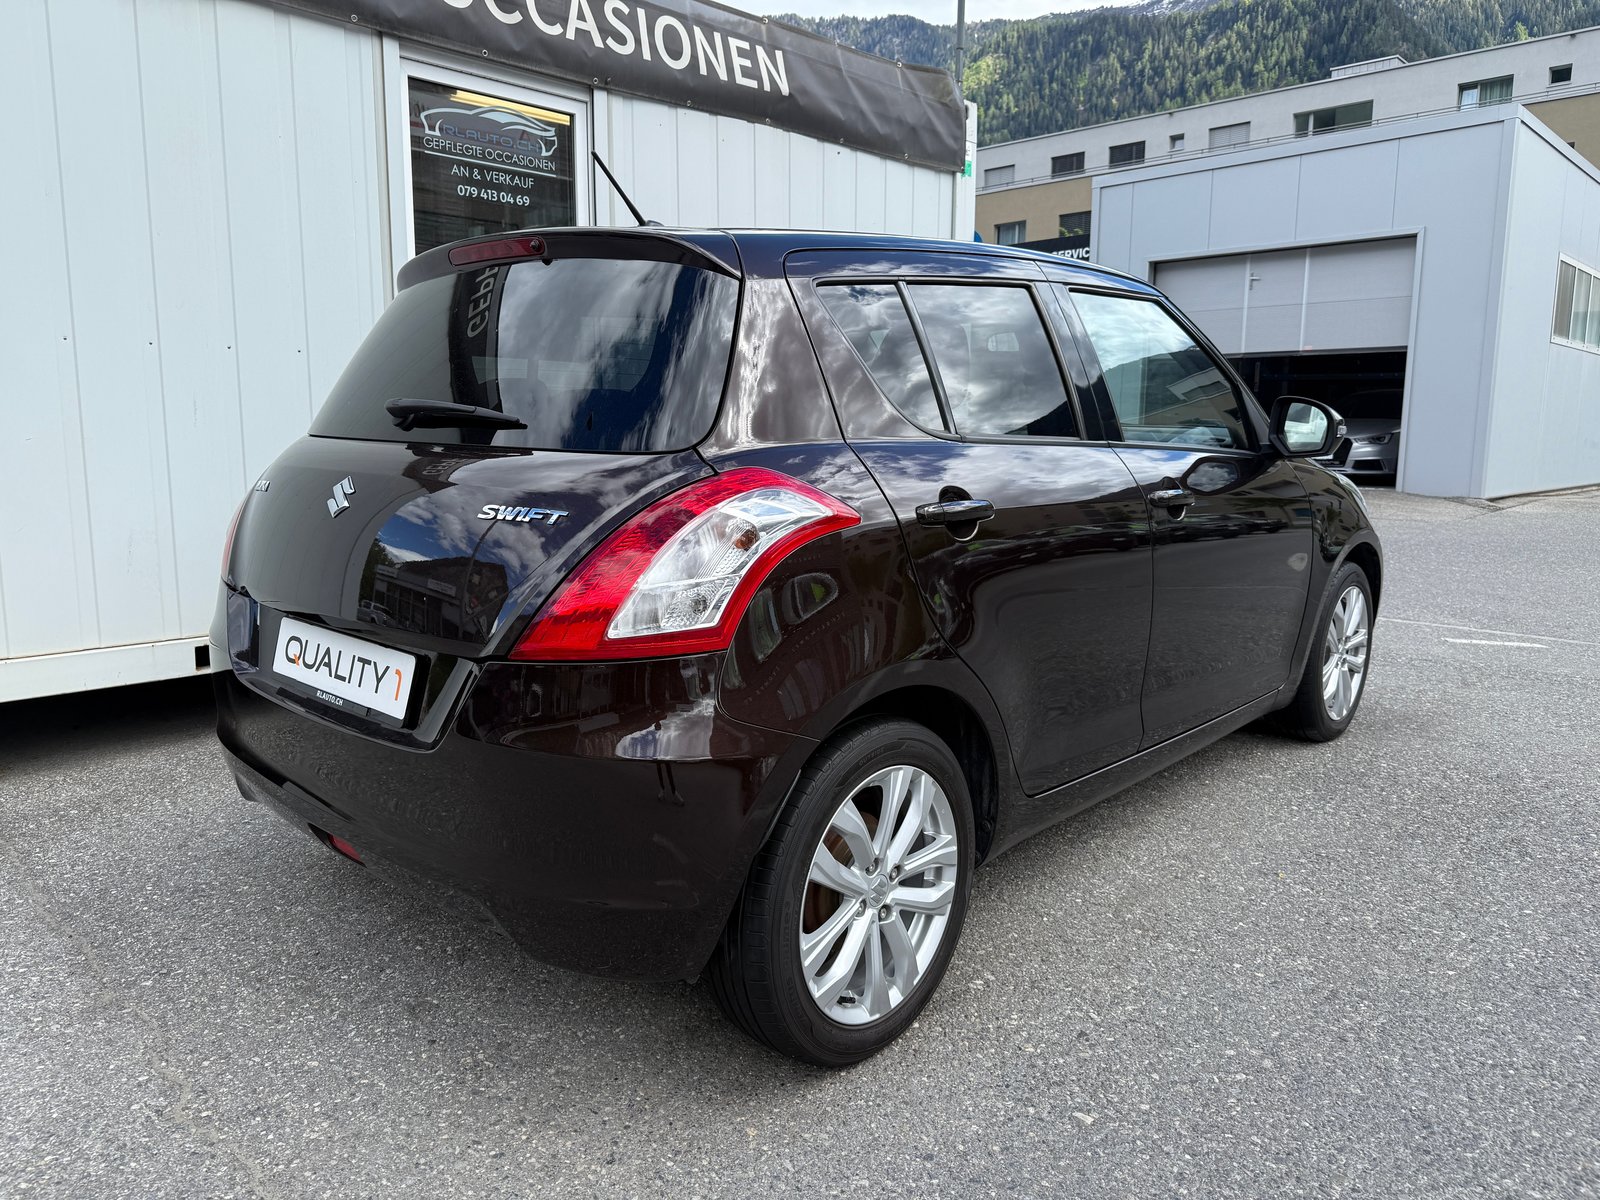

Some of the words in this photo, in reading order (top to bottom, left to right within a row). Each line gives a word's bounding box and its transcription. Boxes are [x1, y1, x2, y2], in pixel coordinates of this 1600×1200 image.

[443, 0, 790, 97] CASIONEN
[442, 123, 540, 153] RLAUTO.CH
[423, 136, 483, 158] GEPFLEGTE
[485, 148, 556, 171] OCCASIONEN
[451, 164, 469, 178] AN
[472, 168, 482, 180] &
[484, 169, 535, 189] VERKAUF
[457, 184, 478, 198] 079
[480, 188, 498, 201] 413
[499, 191, 515, 204] 04
[516, 194, 530, 206] 69
[477, 504, 570, 525] SWIFT
[316, 690, 344, 706] RLAUTO.CH
